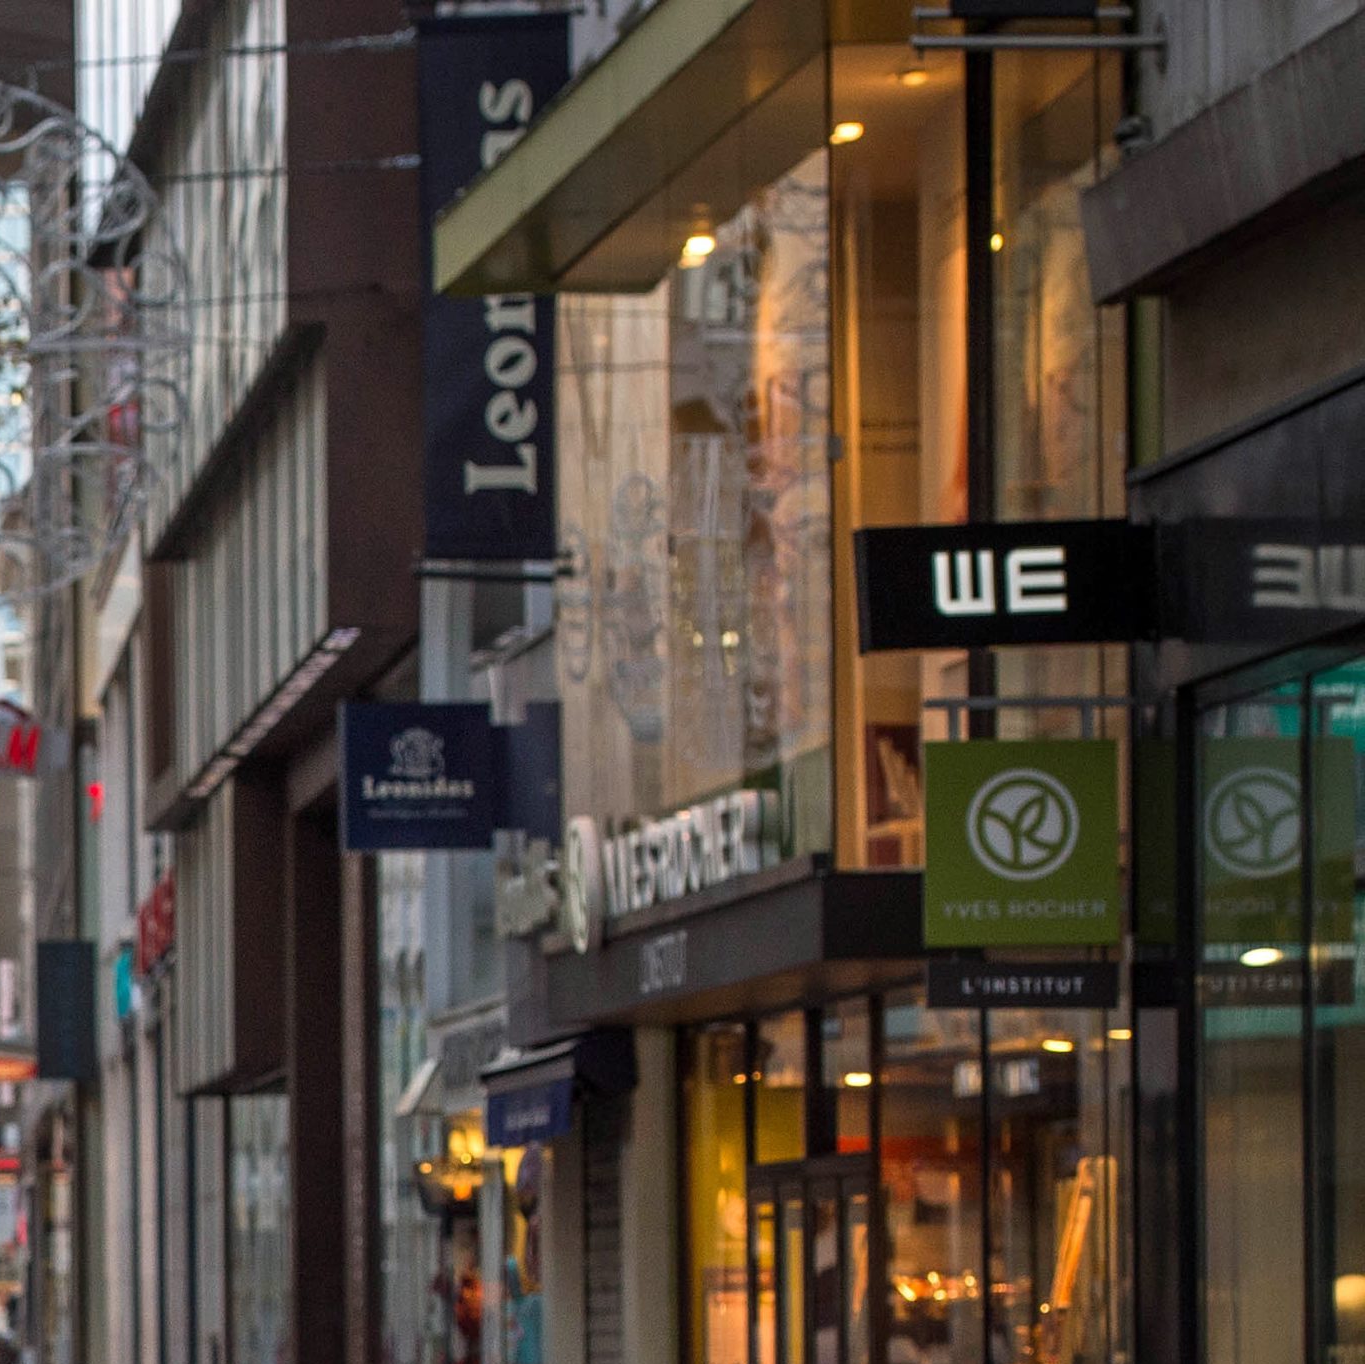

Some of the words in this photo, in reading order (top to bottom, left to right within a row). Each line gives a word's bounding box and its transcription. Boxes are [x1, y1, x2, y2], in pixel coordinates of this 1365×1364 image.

[931, 545, 1068, 618] WE
[944, 899, 1000, 920] YVES
[1007, 898, 1106, 919] ROCHER
[961, 976, 1085, 996] L'INSTITUT
